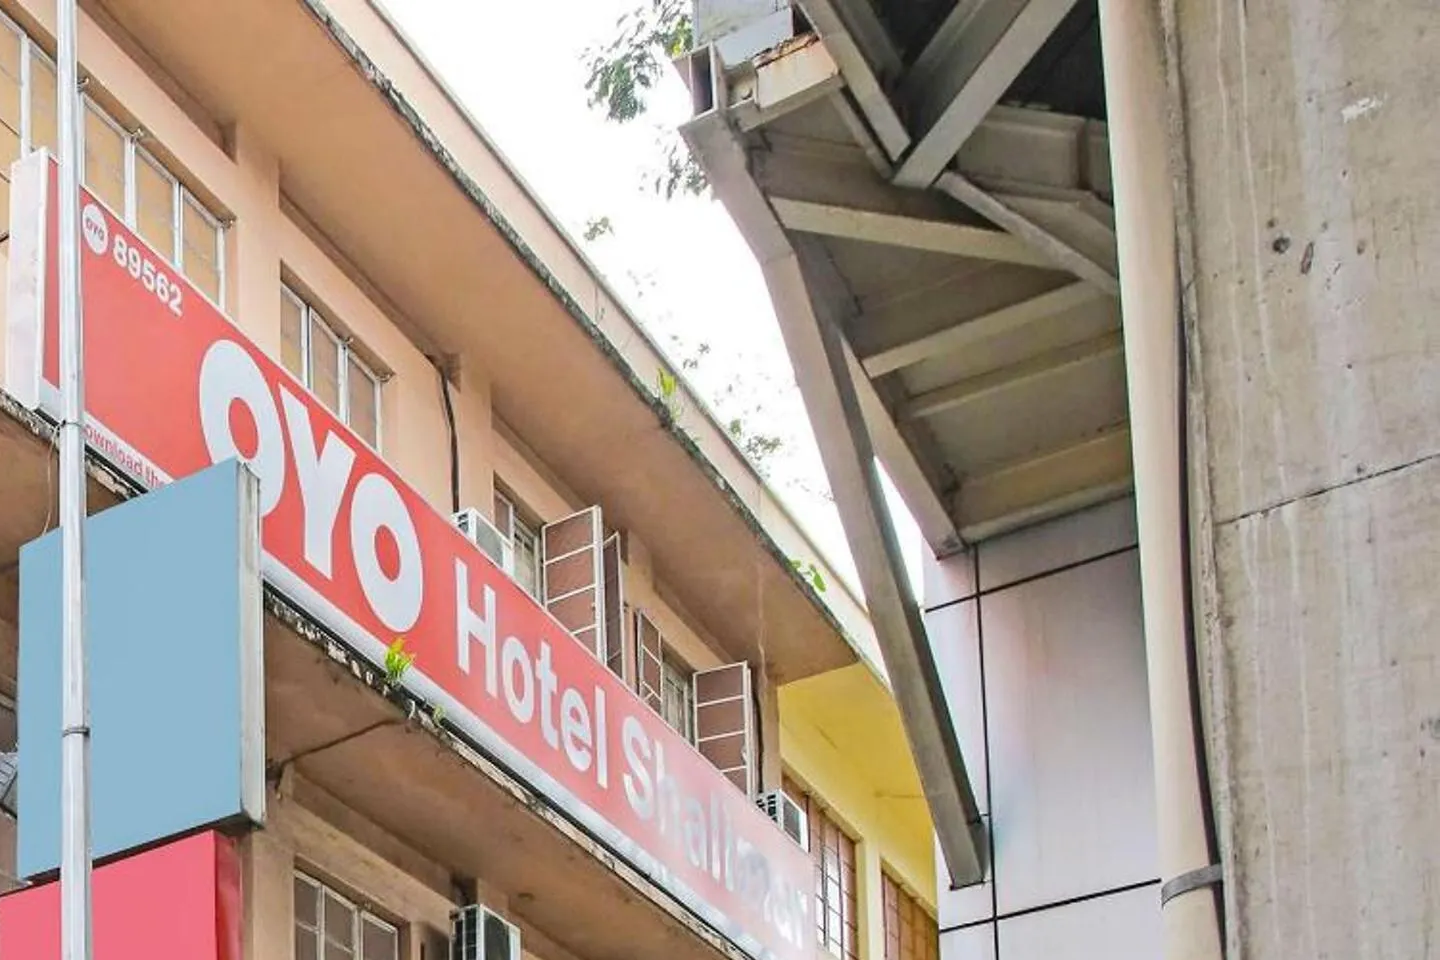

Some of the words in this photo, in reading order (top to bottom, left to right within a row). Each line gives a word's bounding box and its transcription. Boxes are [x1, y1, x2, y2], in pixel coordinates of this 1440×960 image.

[113, 234, 182, 317] 89562
[82, 424, 143, 477] ownload
[199, 339, 424, 633] OYO
[454, 557, 608, 790] Hotel
[621, 716, 808, 950] Shalimar
